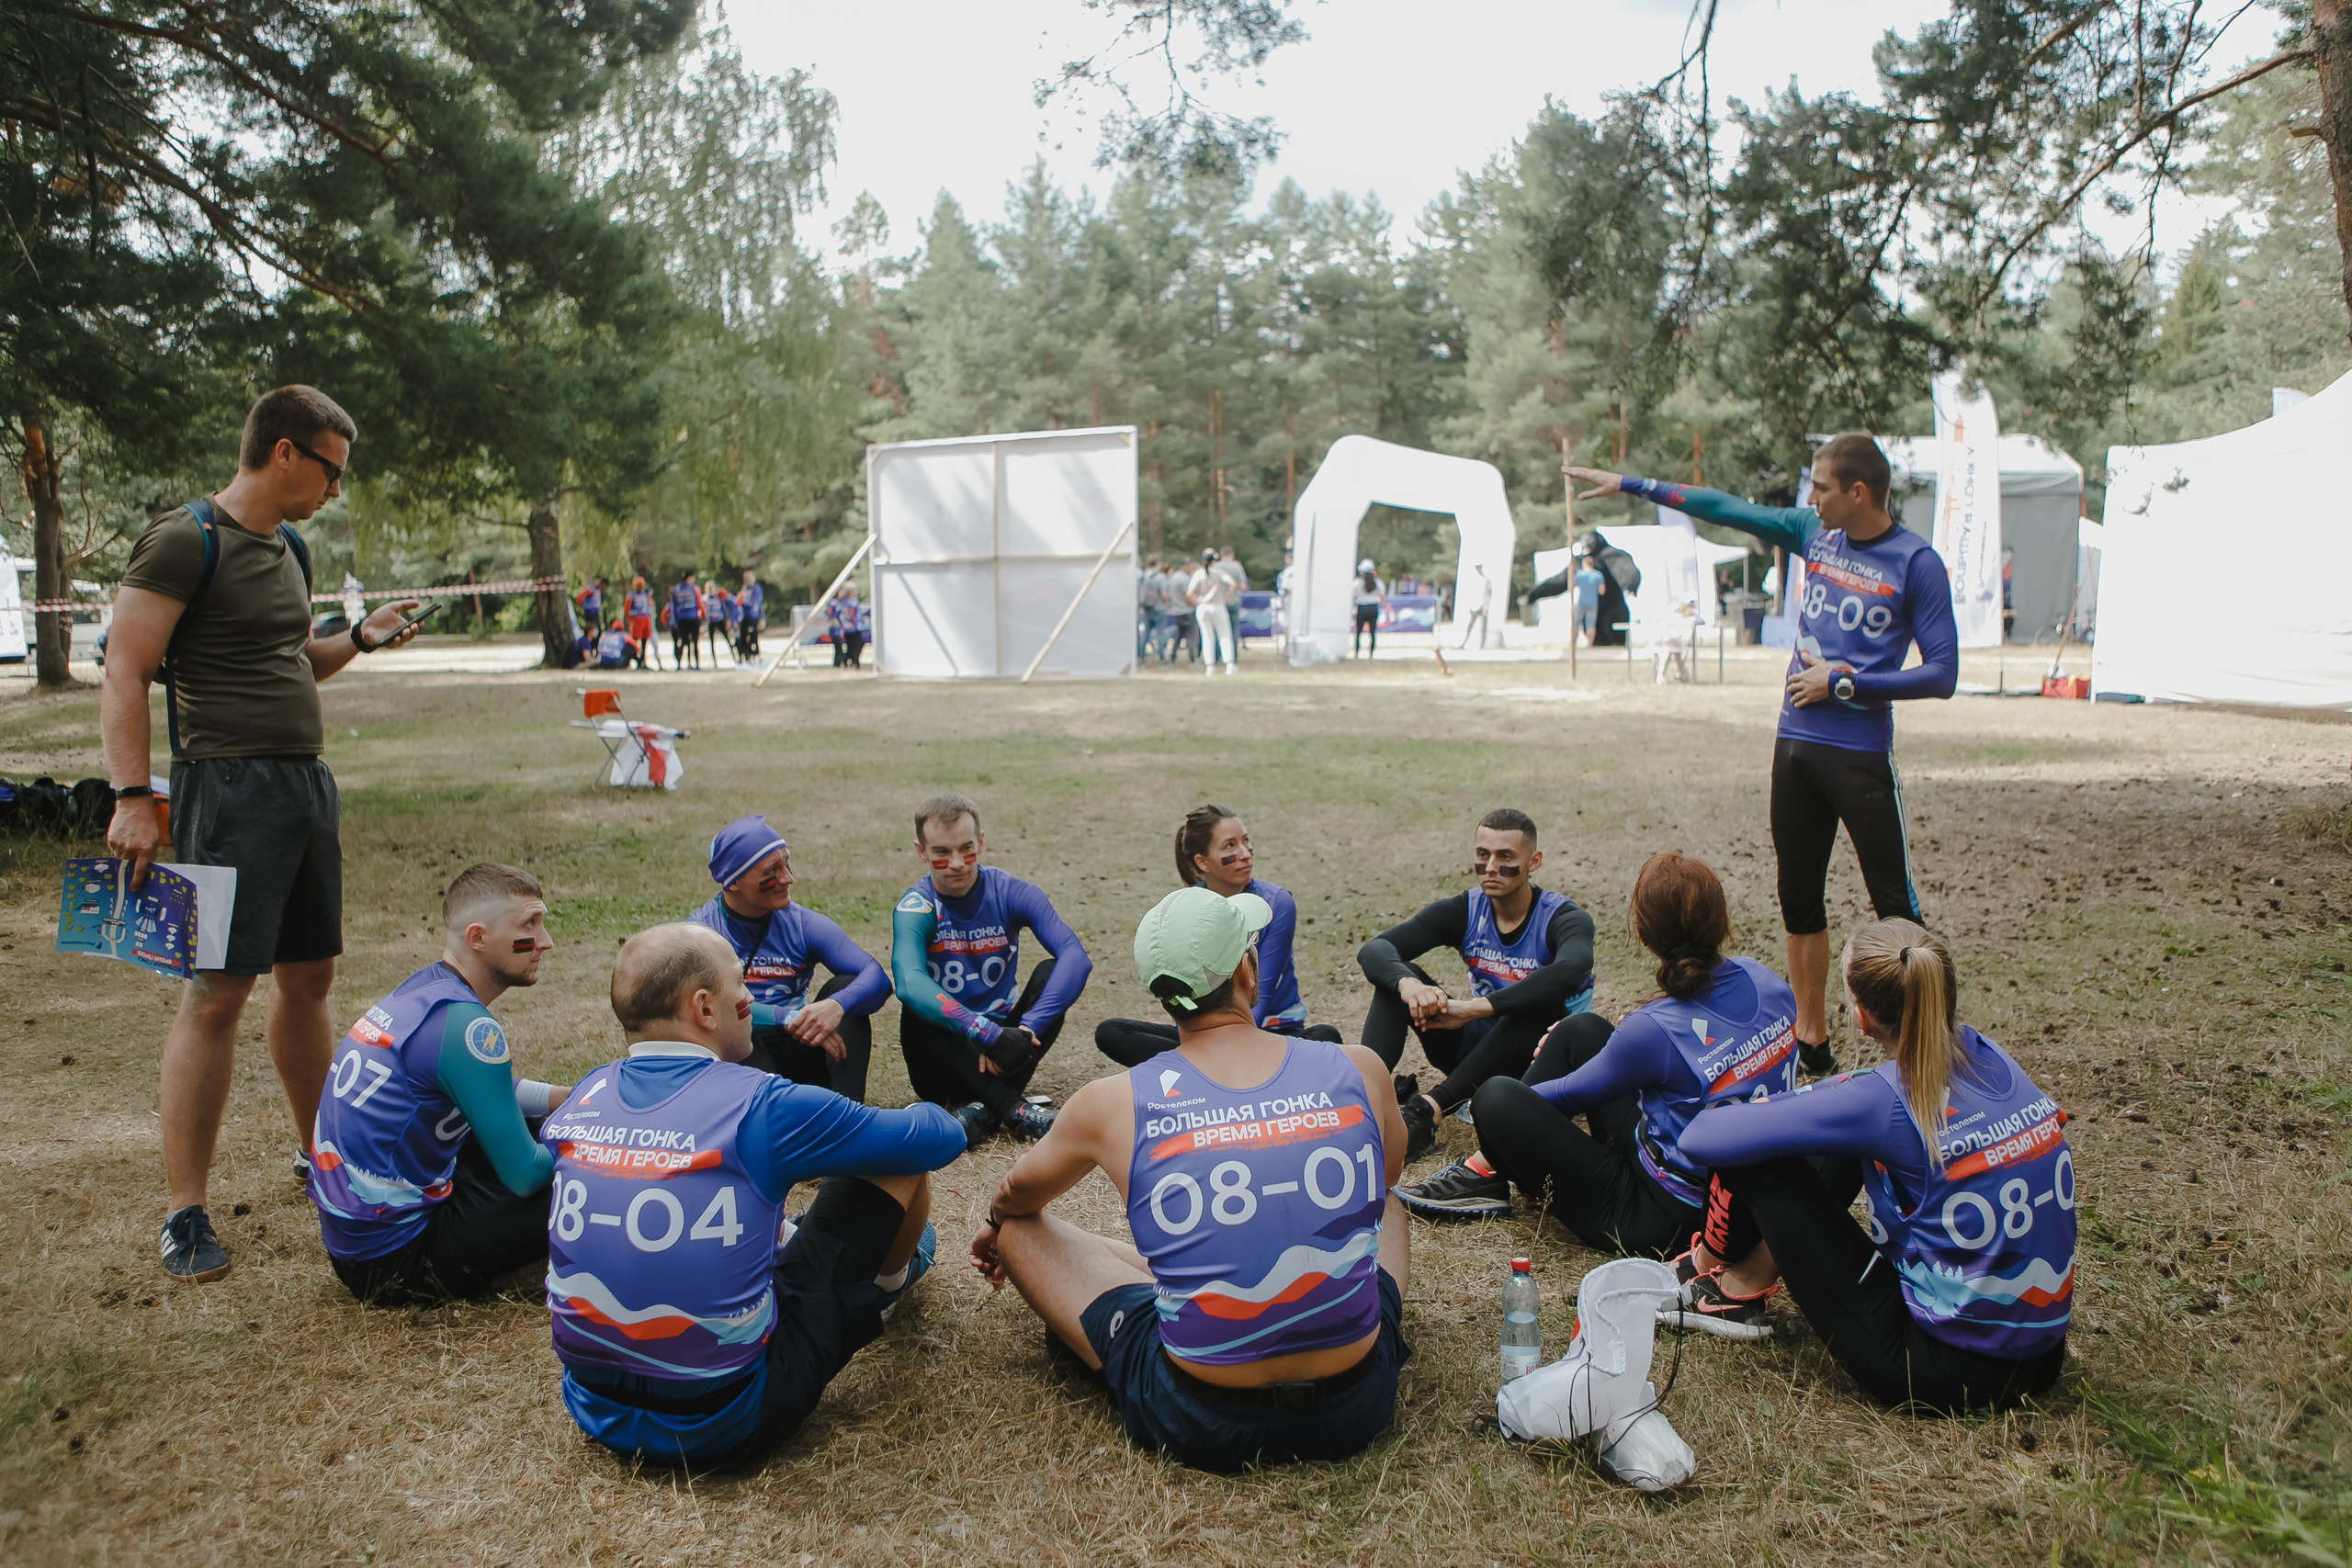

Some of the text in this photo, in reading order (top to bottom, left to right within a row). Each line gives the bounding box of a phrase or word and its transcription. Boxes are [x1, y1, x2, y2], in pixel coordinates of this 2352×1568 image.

[1849, 560, 1883, 581] ГОНКА
[969, 925, 1005, 941] ГОНКА
[1697, 1037, 1735, 1065] Ростелеком
[1703, 1034, 1762, 1082] БОЛЬШАЯ
[1759, 1015, 1791, 1044] ГОНКА
[1733, 1049, 1769, 1080] ВРЕМЯ
[1766, 1029, 1793, 1058] ГЕРОЕВ
[1146, 1091, 1334, 1139] БОЛЬШАЯ ГОНКА
[1147, 1097, 1206, 1111] Ростелеком
[547, 1123, 696, 1152] БОЛЬШАЯ ГОНКА
[1193, 1111, 1340, 1148] ВРЕМЯ ГЕРОЕВ
[1939, 1111, 1986, 1137] остелеком
[1940, 1112, 2025, 1161] БОЛЬШАЯ
[572, 1143, 693, 1169] ВРЕМЯ ГЕРОЕВ
[1984, 1133, 2035, 1167] ВРЕМЯ
[1150, 1144, 1377, 1235] 08-01
